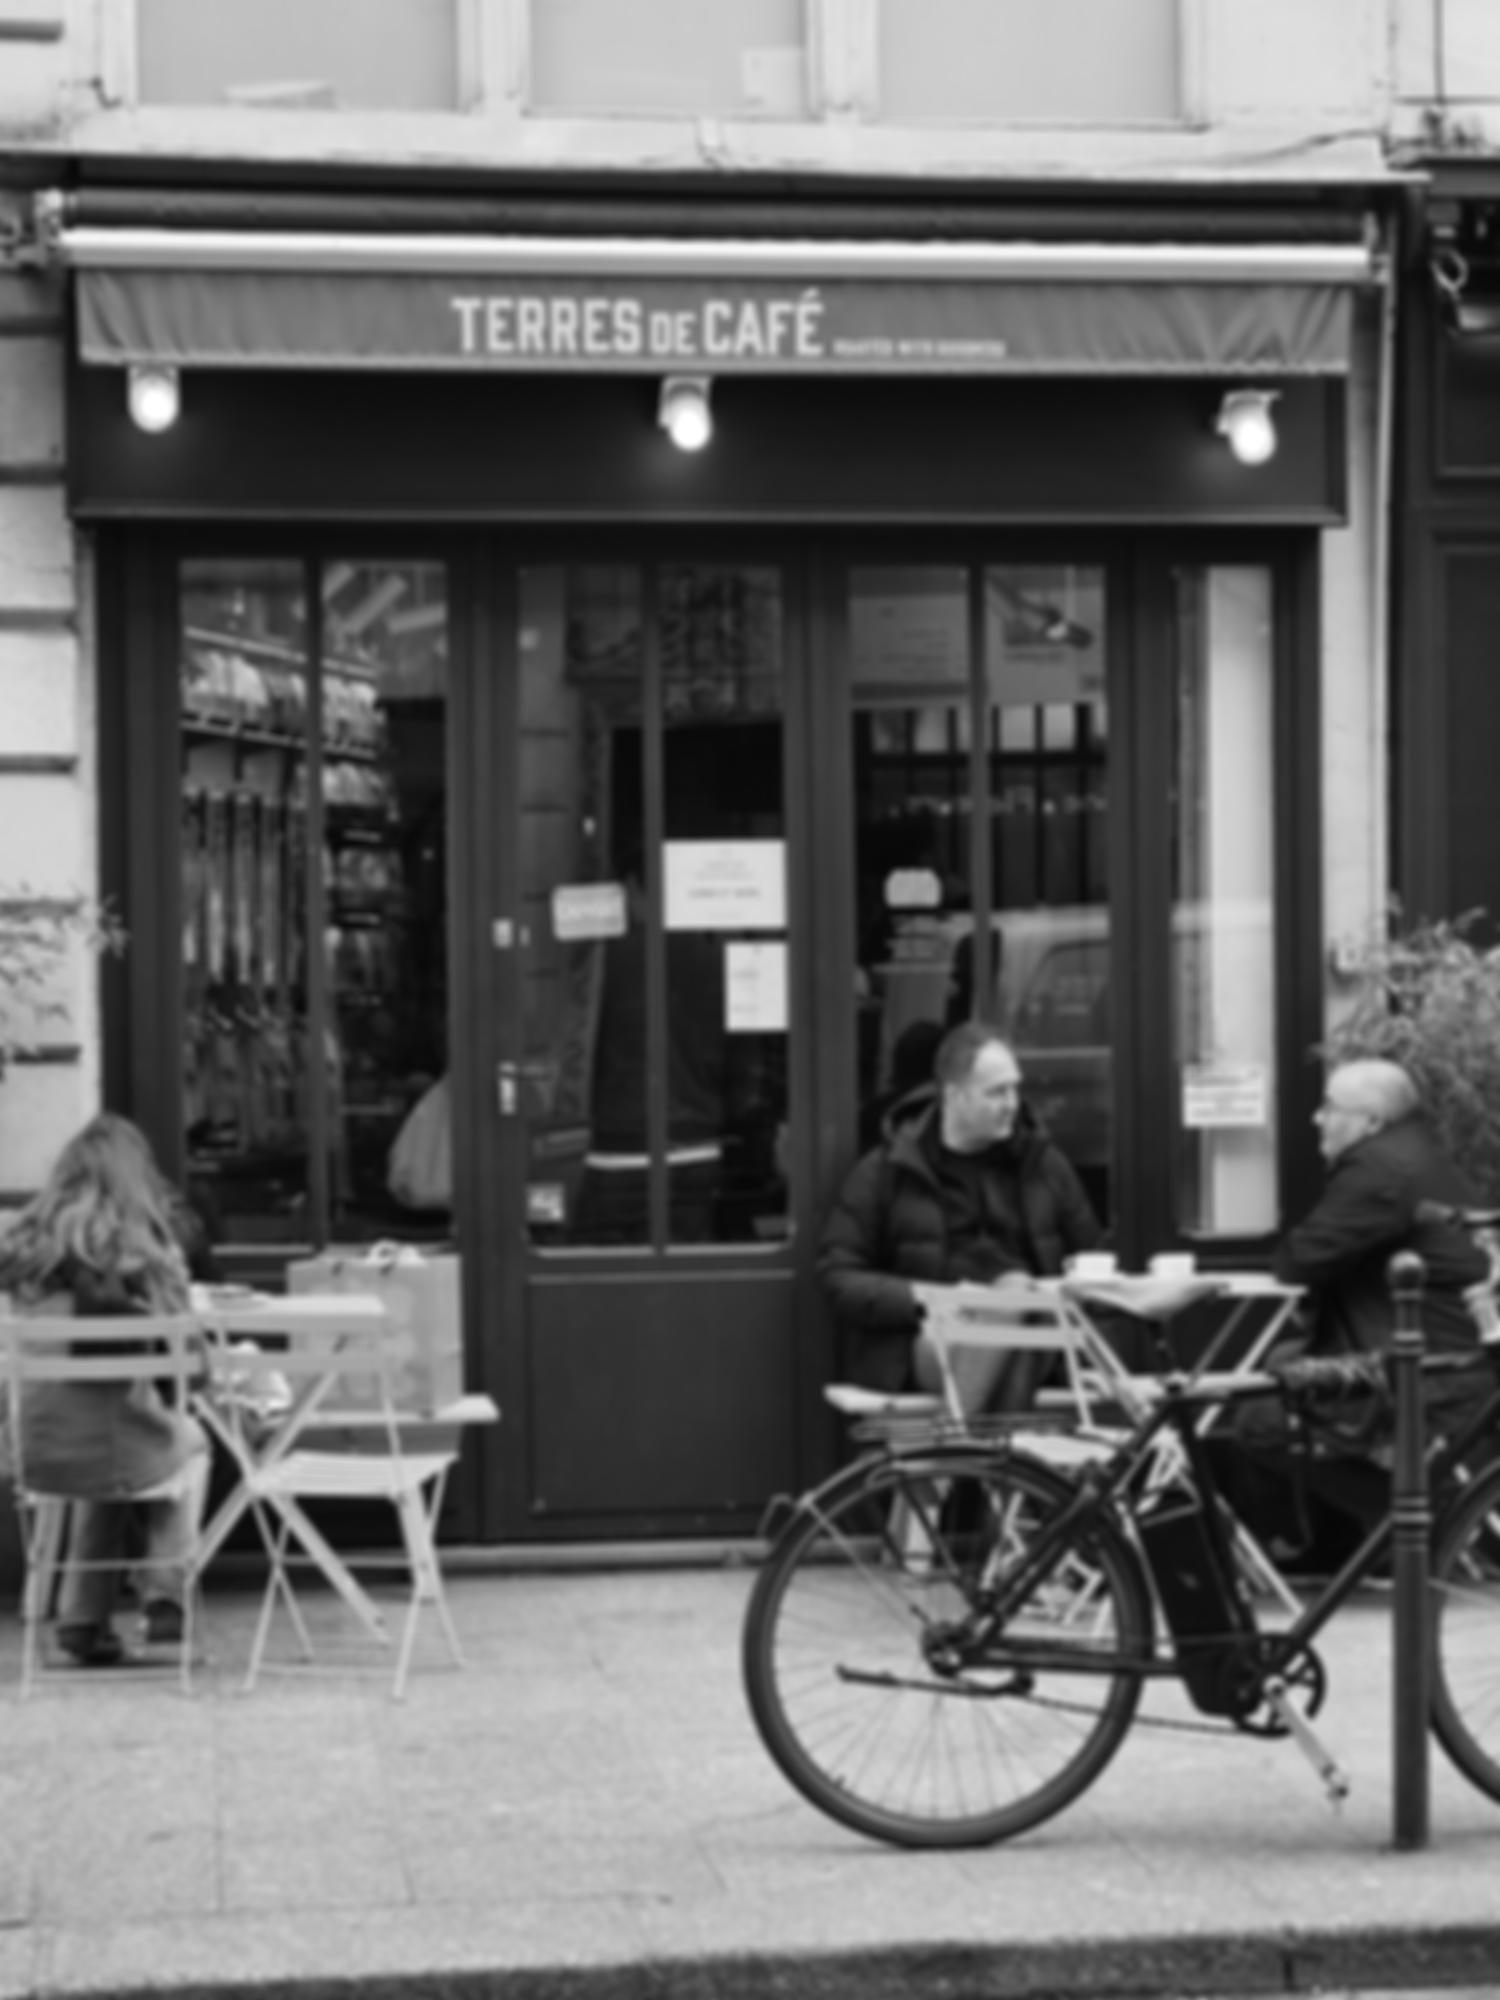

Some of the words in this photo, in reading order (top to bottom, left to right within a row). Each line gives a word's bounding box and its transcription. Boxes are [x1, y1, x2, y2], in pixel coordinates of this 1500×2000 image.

[452, 297, 642, 354] TERRES
[650, 310, 697, 354] DE
[703, 287, 825, 356] CAFÉ
